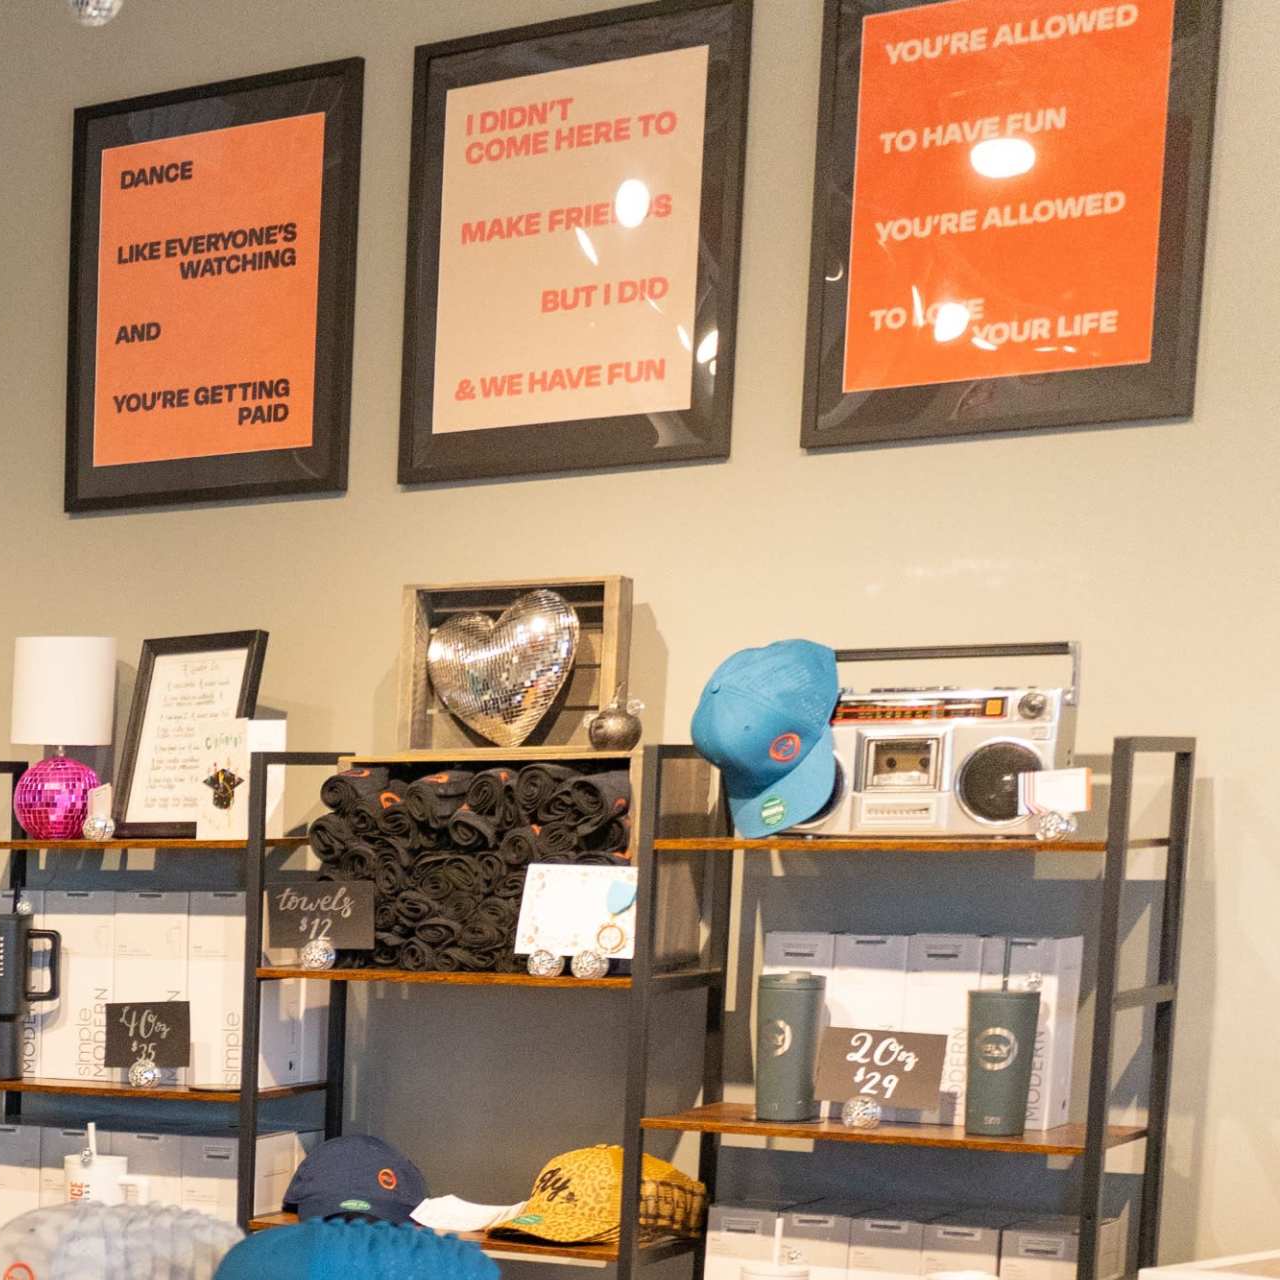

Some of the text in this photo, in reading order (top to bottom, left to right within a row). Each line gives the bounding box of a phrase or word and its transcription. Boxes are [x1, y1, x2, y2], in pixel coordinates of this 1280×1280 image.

[886, 4, 1139, 65] YOU'RE ALLOWED
[466, 98, 574, 137] I DIDN'T
[880, 106, 1067, 154] TO HAVE FUN
[465, 111, 678, 165] COME HERE TO
[120, 161, 194, 190] DANCE
[461, 194, 673, 246] MAKE FRIES
[875, 191, 1127, 243] YOU'RE ALLOWED
[117, 222, 298, 265] LIKE EVERYONE'S
[180, 248, 297, 281] WATCHING
[541, 276, 669, 313] BUT I DID
[115, 322, 162, 345] AND
[870, 307, 907, 332] TO
[972, 310, 1119, 346] YOUR LIFE
[112, 378, 291, 414] YOU'RE GETTING
[455, 358, 666, 401] & WE HAVE FUN
[237, 403, 290, 426] PAID
[275, 887, 355, 918] towels
[299, 917, 332, 940] $12
[93, 987, 108, 1078] MODERN
[846, 1032, 919, 1072] 20oz
[853, 1067, 900, 1099] $29
